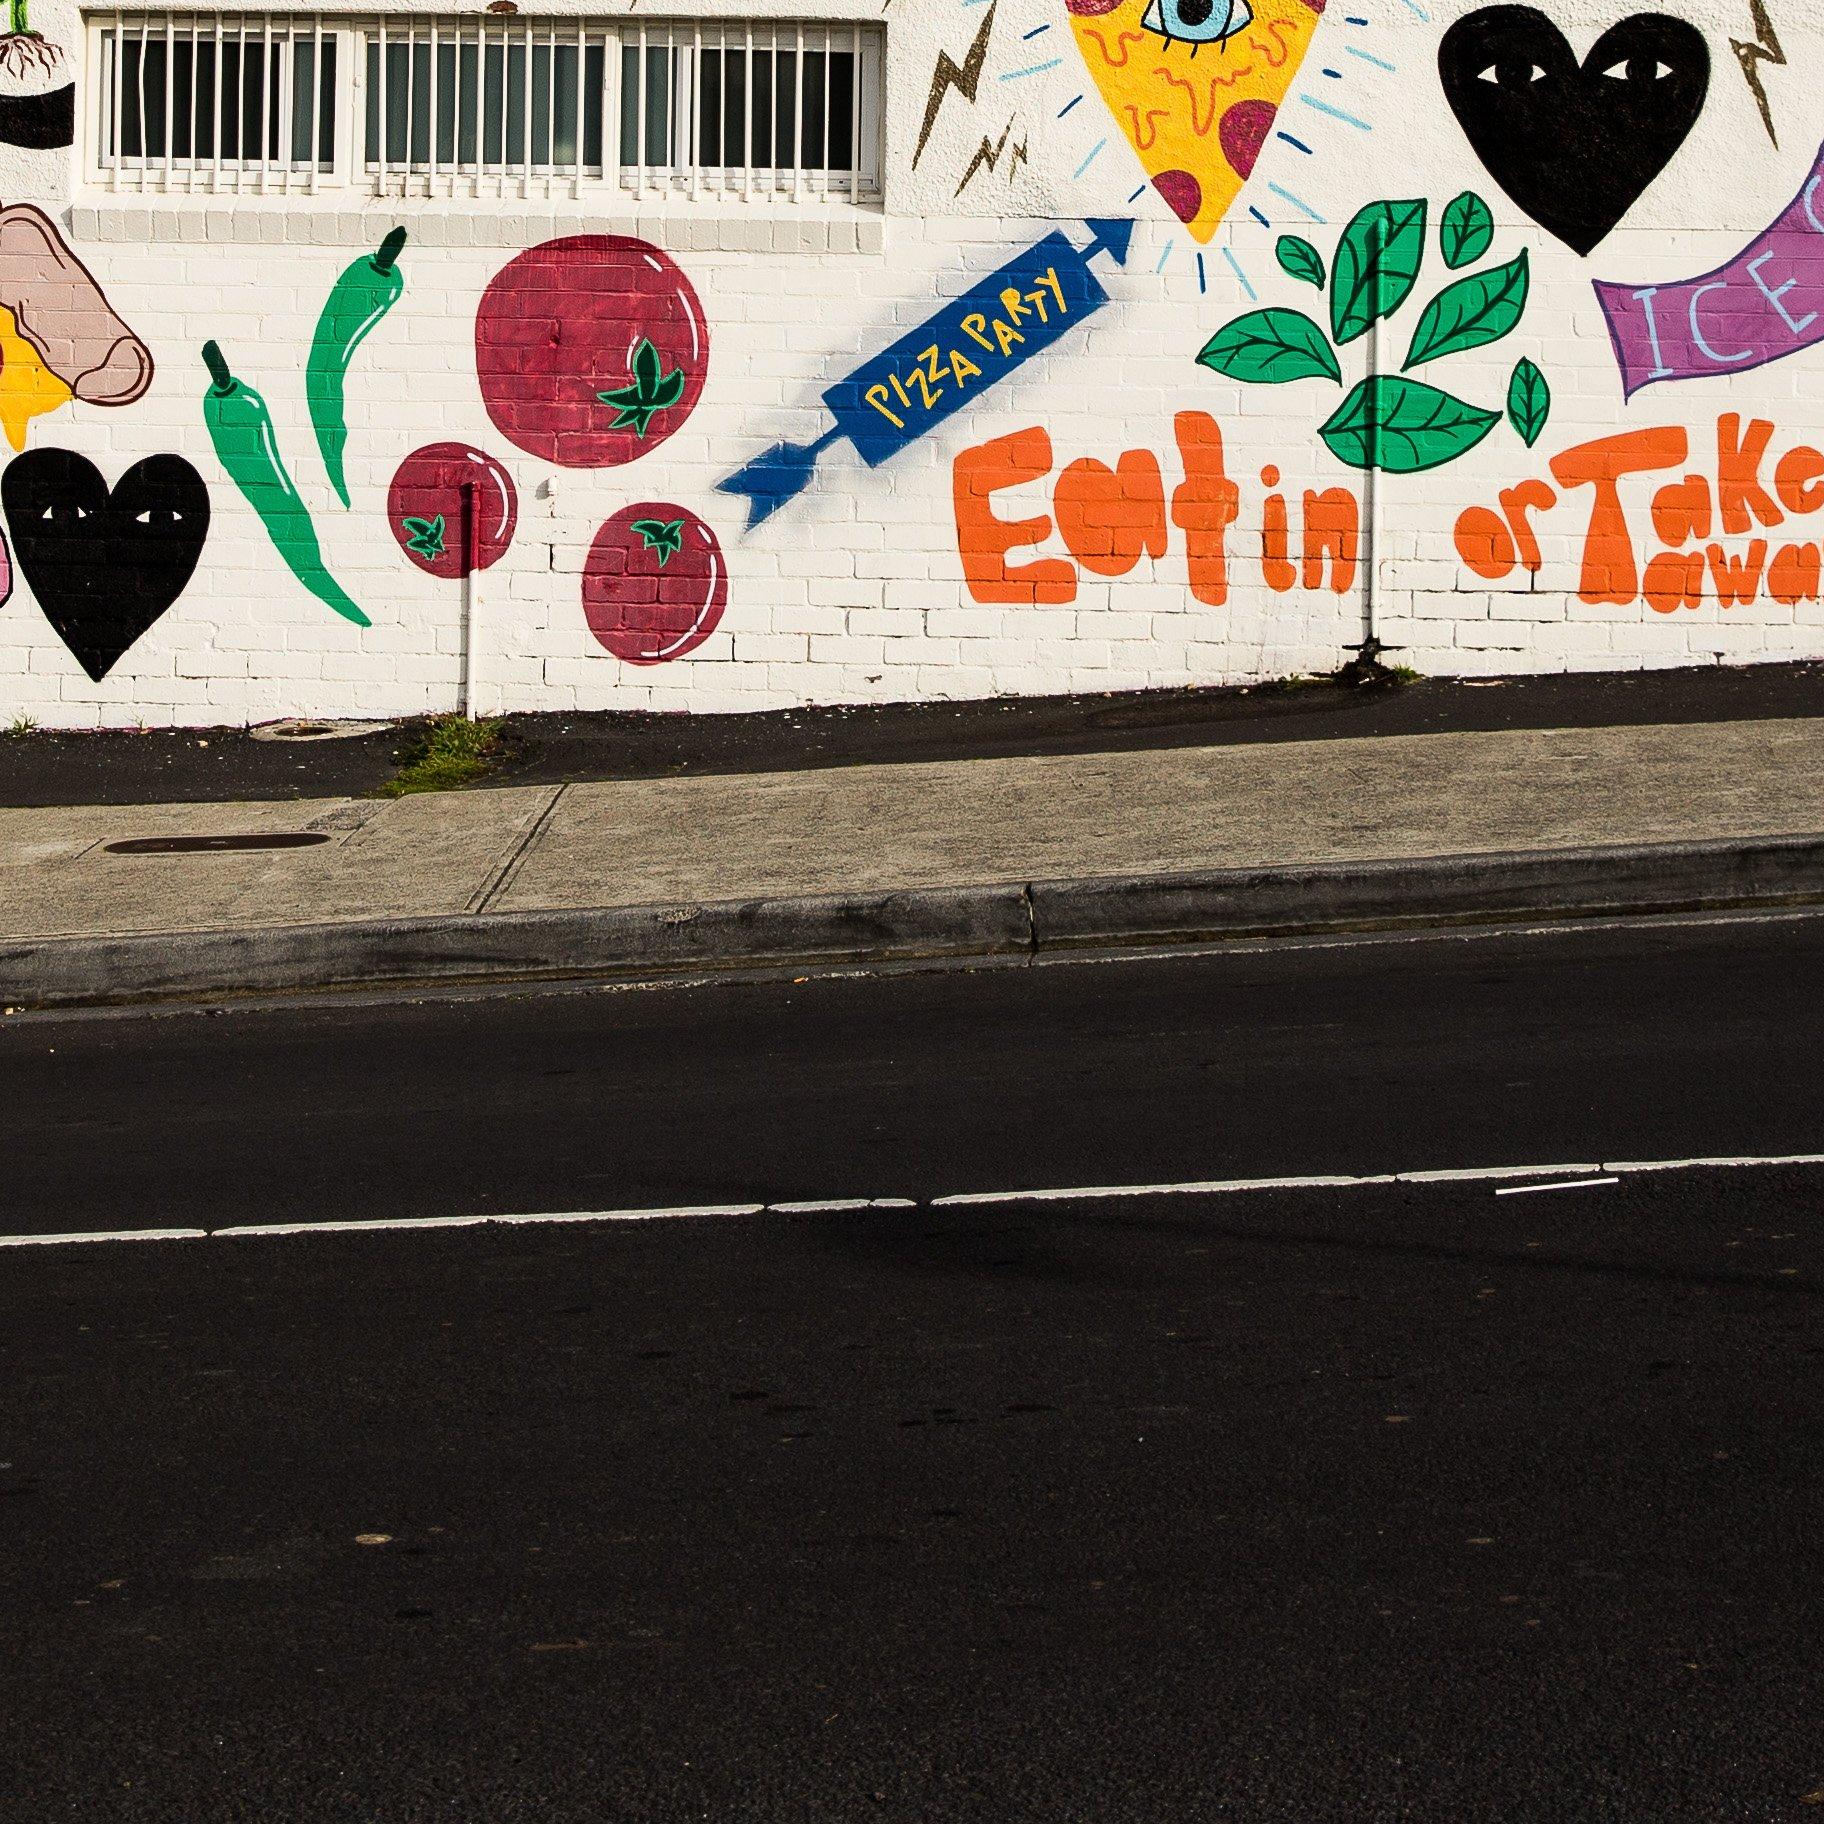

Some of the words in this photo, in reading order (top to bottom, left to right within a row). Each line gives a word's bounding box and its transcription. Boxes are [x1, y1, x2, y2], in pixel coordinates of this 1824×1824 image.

[865, 344, 982, 429] PIZZA
[960, 267, 1068, 358] PARTY
[1632, 250, 1819, 380] ICE
[952, 410, 1240, 607] Eat
[1260, 463, 1360, 595] in
[1452, 479, 1558, 580] or
